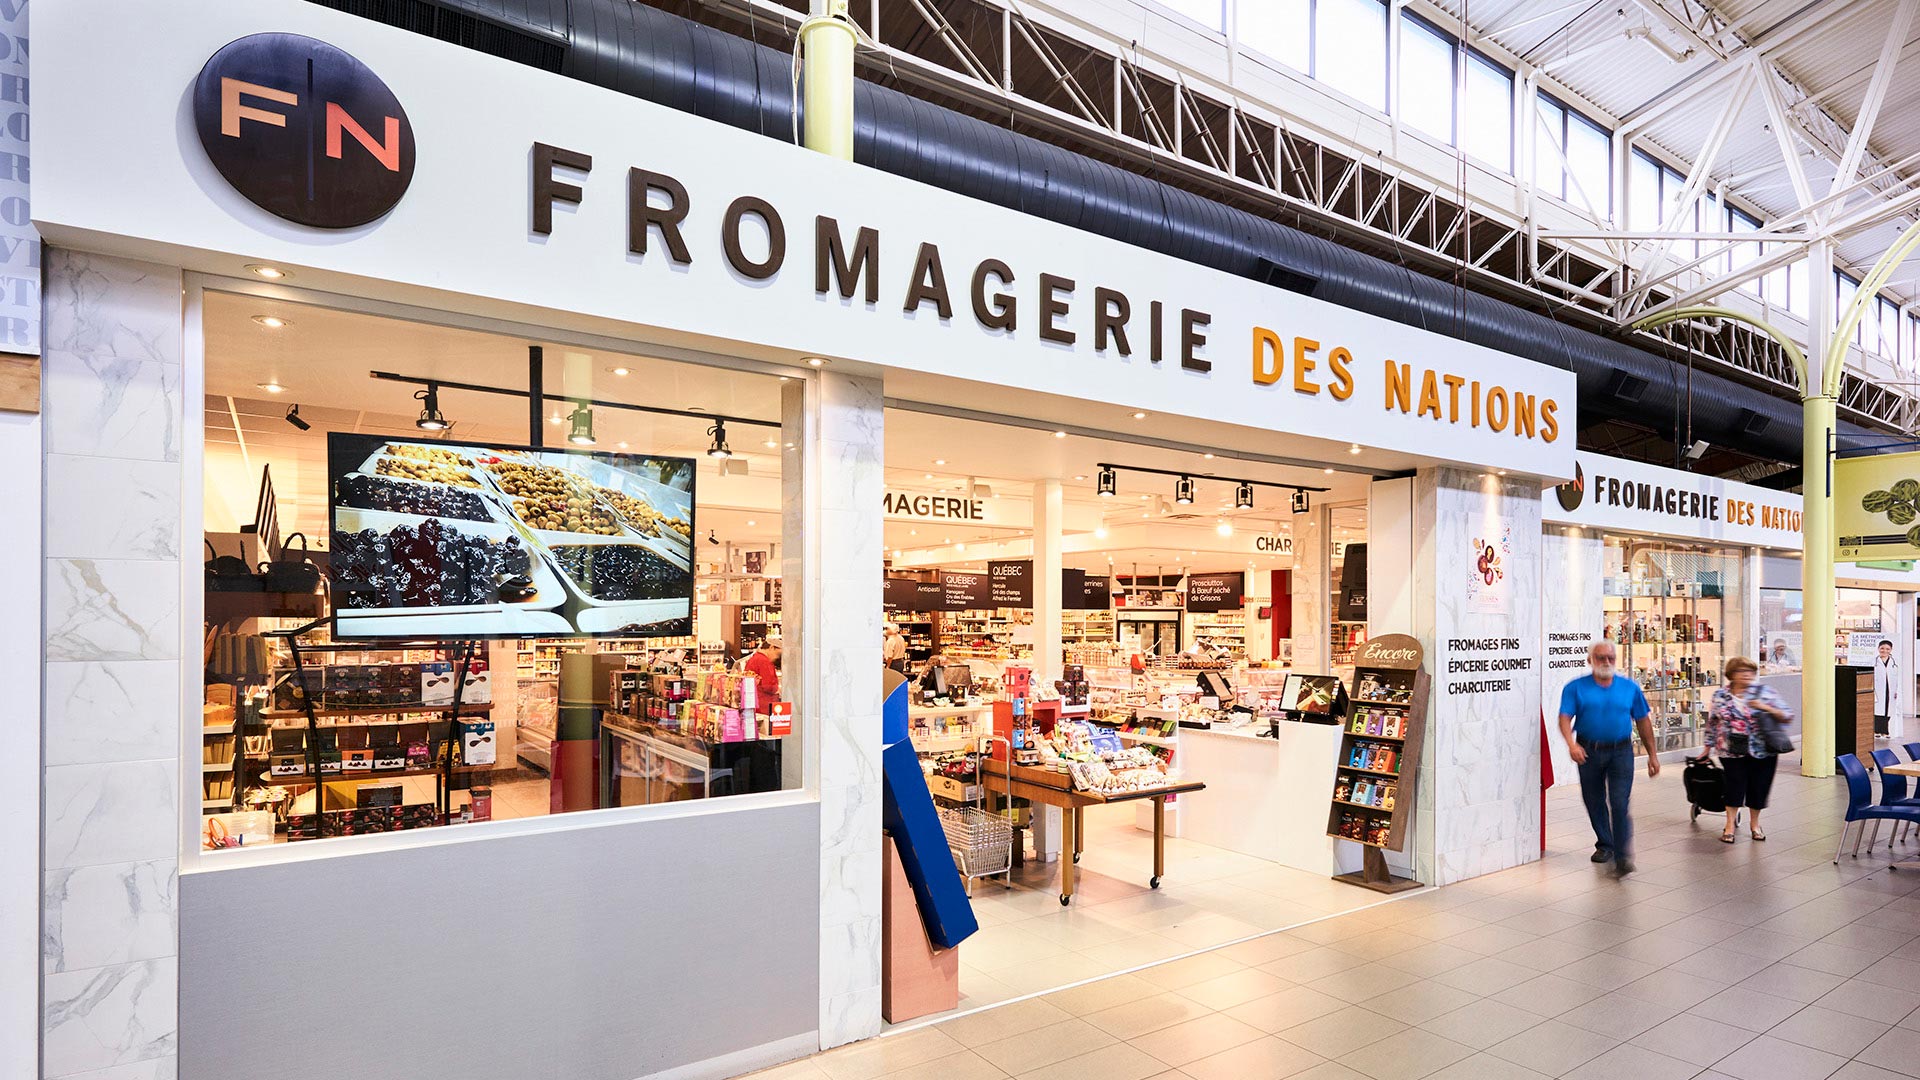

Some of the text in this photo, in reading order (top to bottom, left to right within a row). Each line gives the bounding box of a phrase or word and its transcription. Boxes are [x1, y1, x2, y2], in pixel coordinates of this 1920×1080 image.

[532, 141, 1558, 443] FROMAGERIE DES NATIONS
[1595, 475, 1803, 534] FROMAGERIE DES NATIO
[992, 564, 1023, 576] QUÉBEC
[945, 575, 977, 585] QUÉBEC
[1084, 579, 1104, 588] errines
[1191, 579, 1223, 587] Prosciuttos
[1214, 586, 1231, 594] séché
[1548, 632, 1591, 641] FROMAGES FINS
[1448, 638, 1520, 651] FROMAGES FINS
[1364, 642, 1417, 661] Encore
[1448, 657, 1532, 673] ÉPICERIE GOURMET
[1548, 659, 1586, 669] CHARCUTERIE
[1448, 679, 1511, 695] CHARCUTERIE
